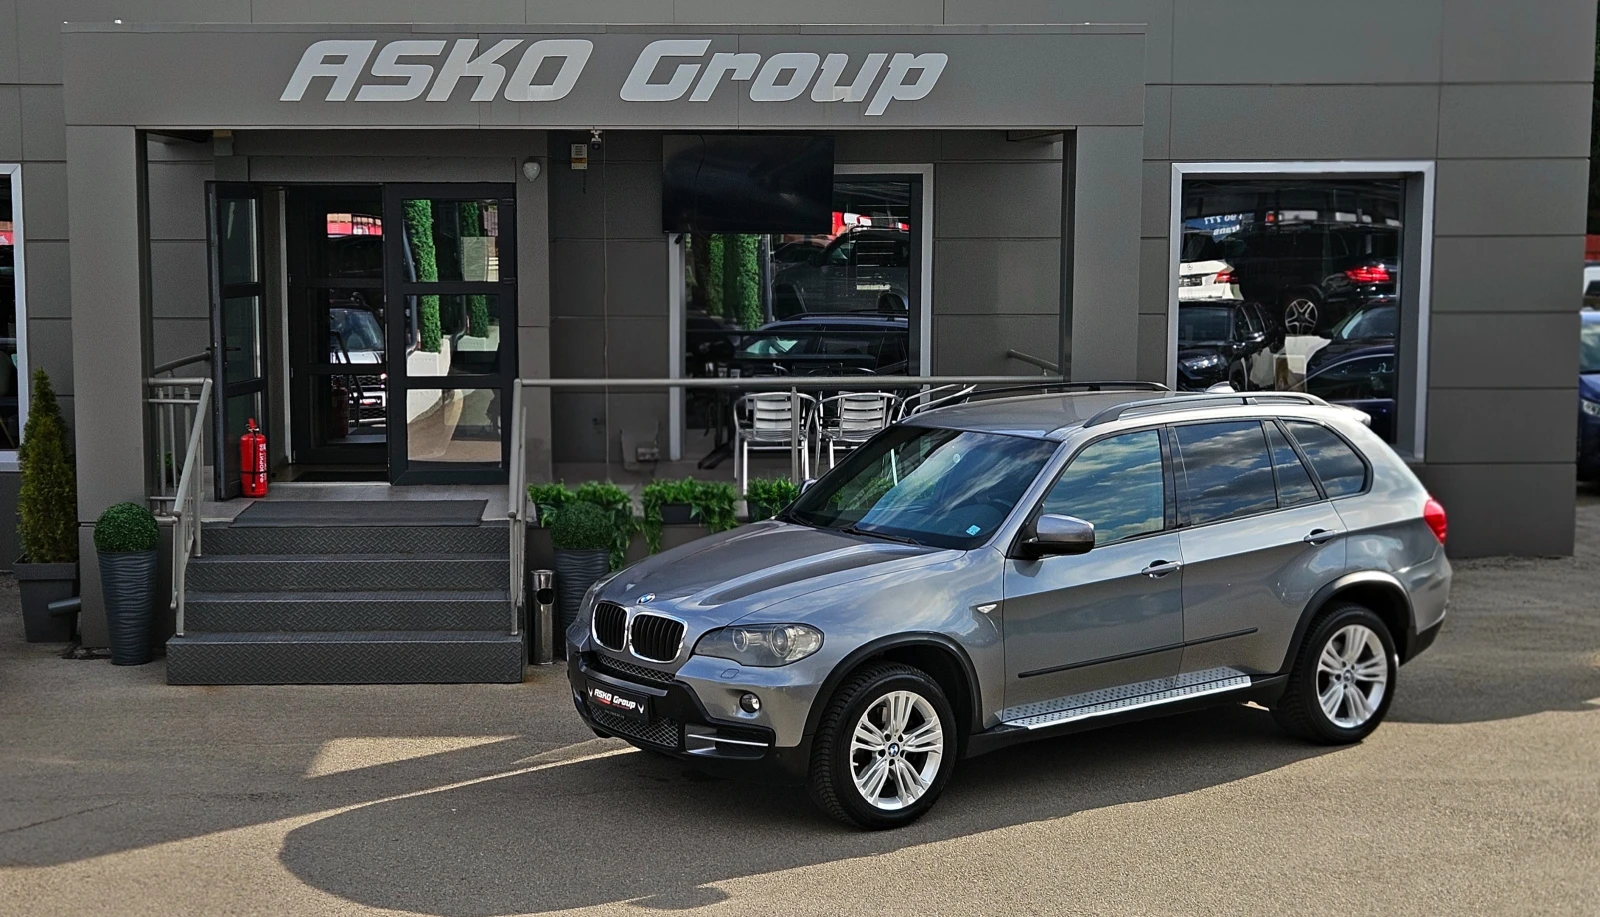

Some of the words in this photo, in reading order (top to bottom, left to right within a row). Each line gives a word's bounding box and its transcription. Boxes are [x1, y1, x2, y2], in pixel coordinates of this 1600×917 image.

[280, 39, 594, 102] ASKO
[620, 39, 949, 116] Group
[594, 689, 612, 701] ASKO
[613, 696, 636, 710] Group
